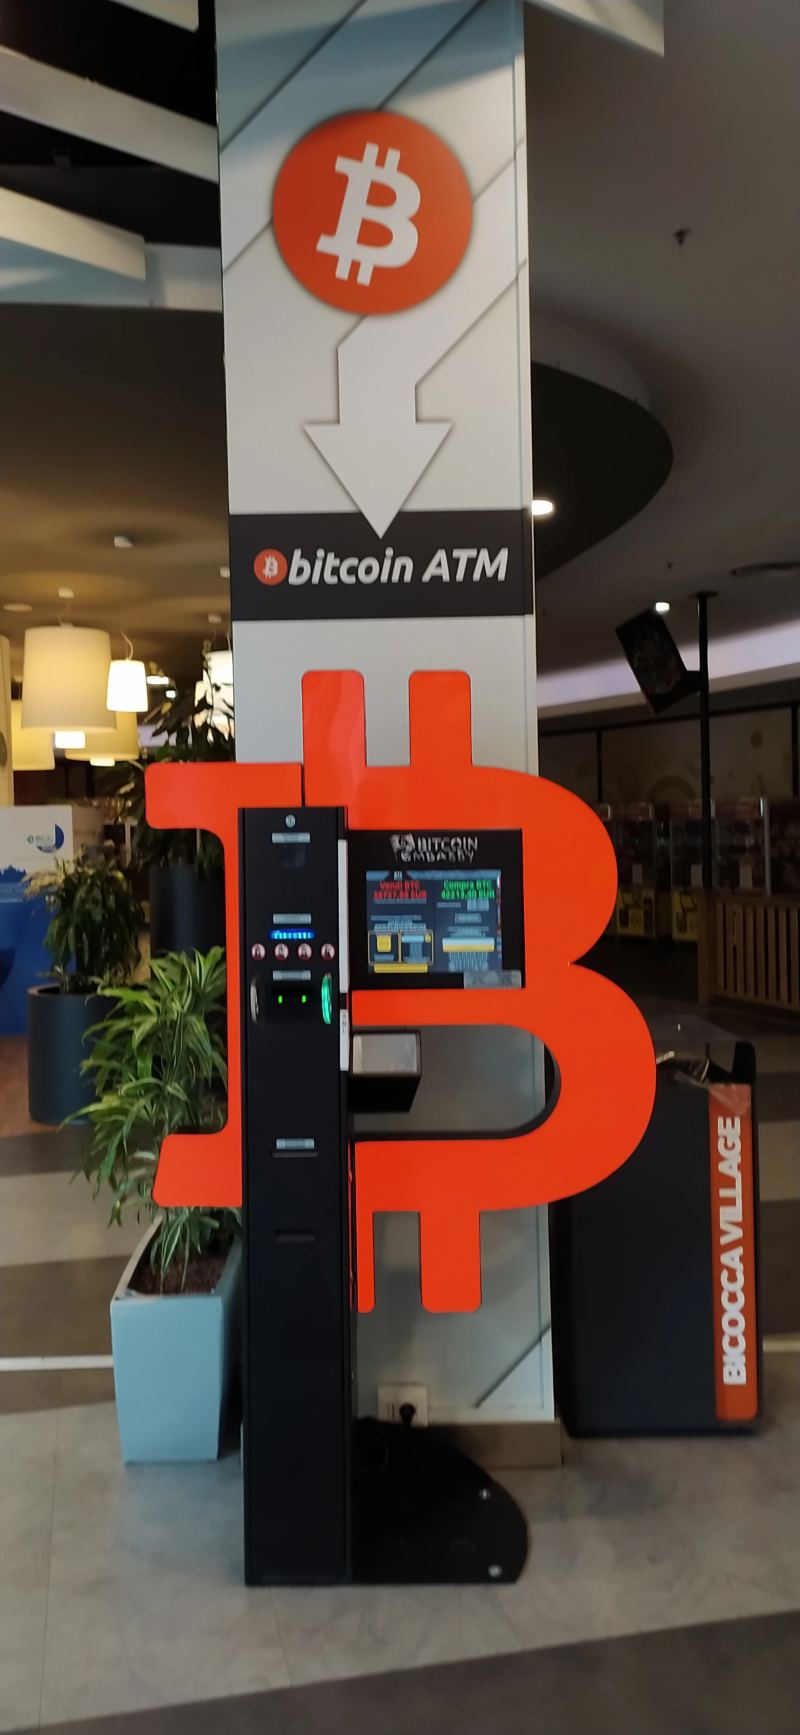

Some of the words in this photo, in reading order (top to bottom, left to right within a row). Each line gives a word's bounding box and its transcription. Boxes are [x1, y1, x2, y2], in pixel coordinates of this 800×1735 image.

[288, 547, 414, 586] bitcoin
[421, 547, 509, 583] ATM
[417, 836, 478, 852] BITCOIN
[717, 1115, 744, 1246] VILLAGE
[719, 1246, 747, 1385] BICOCCA
